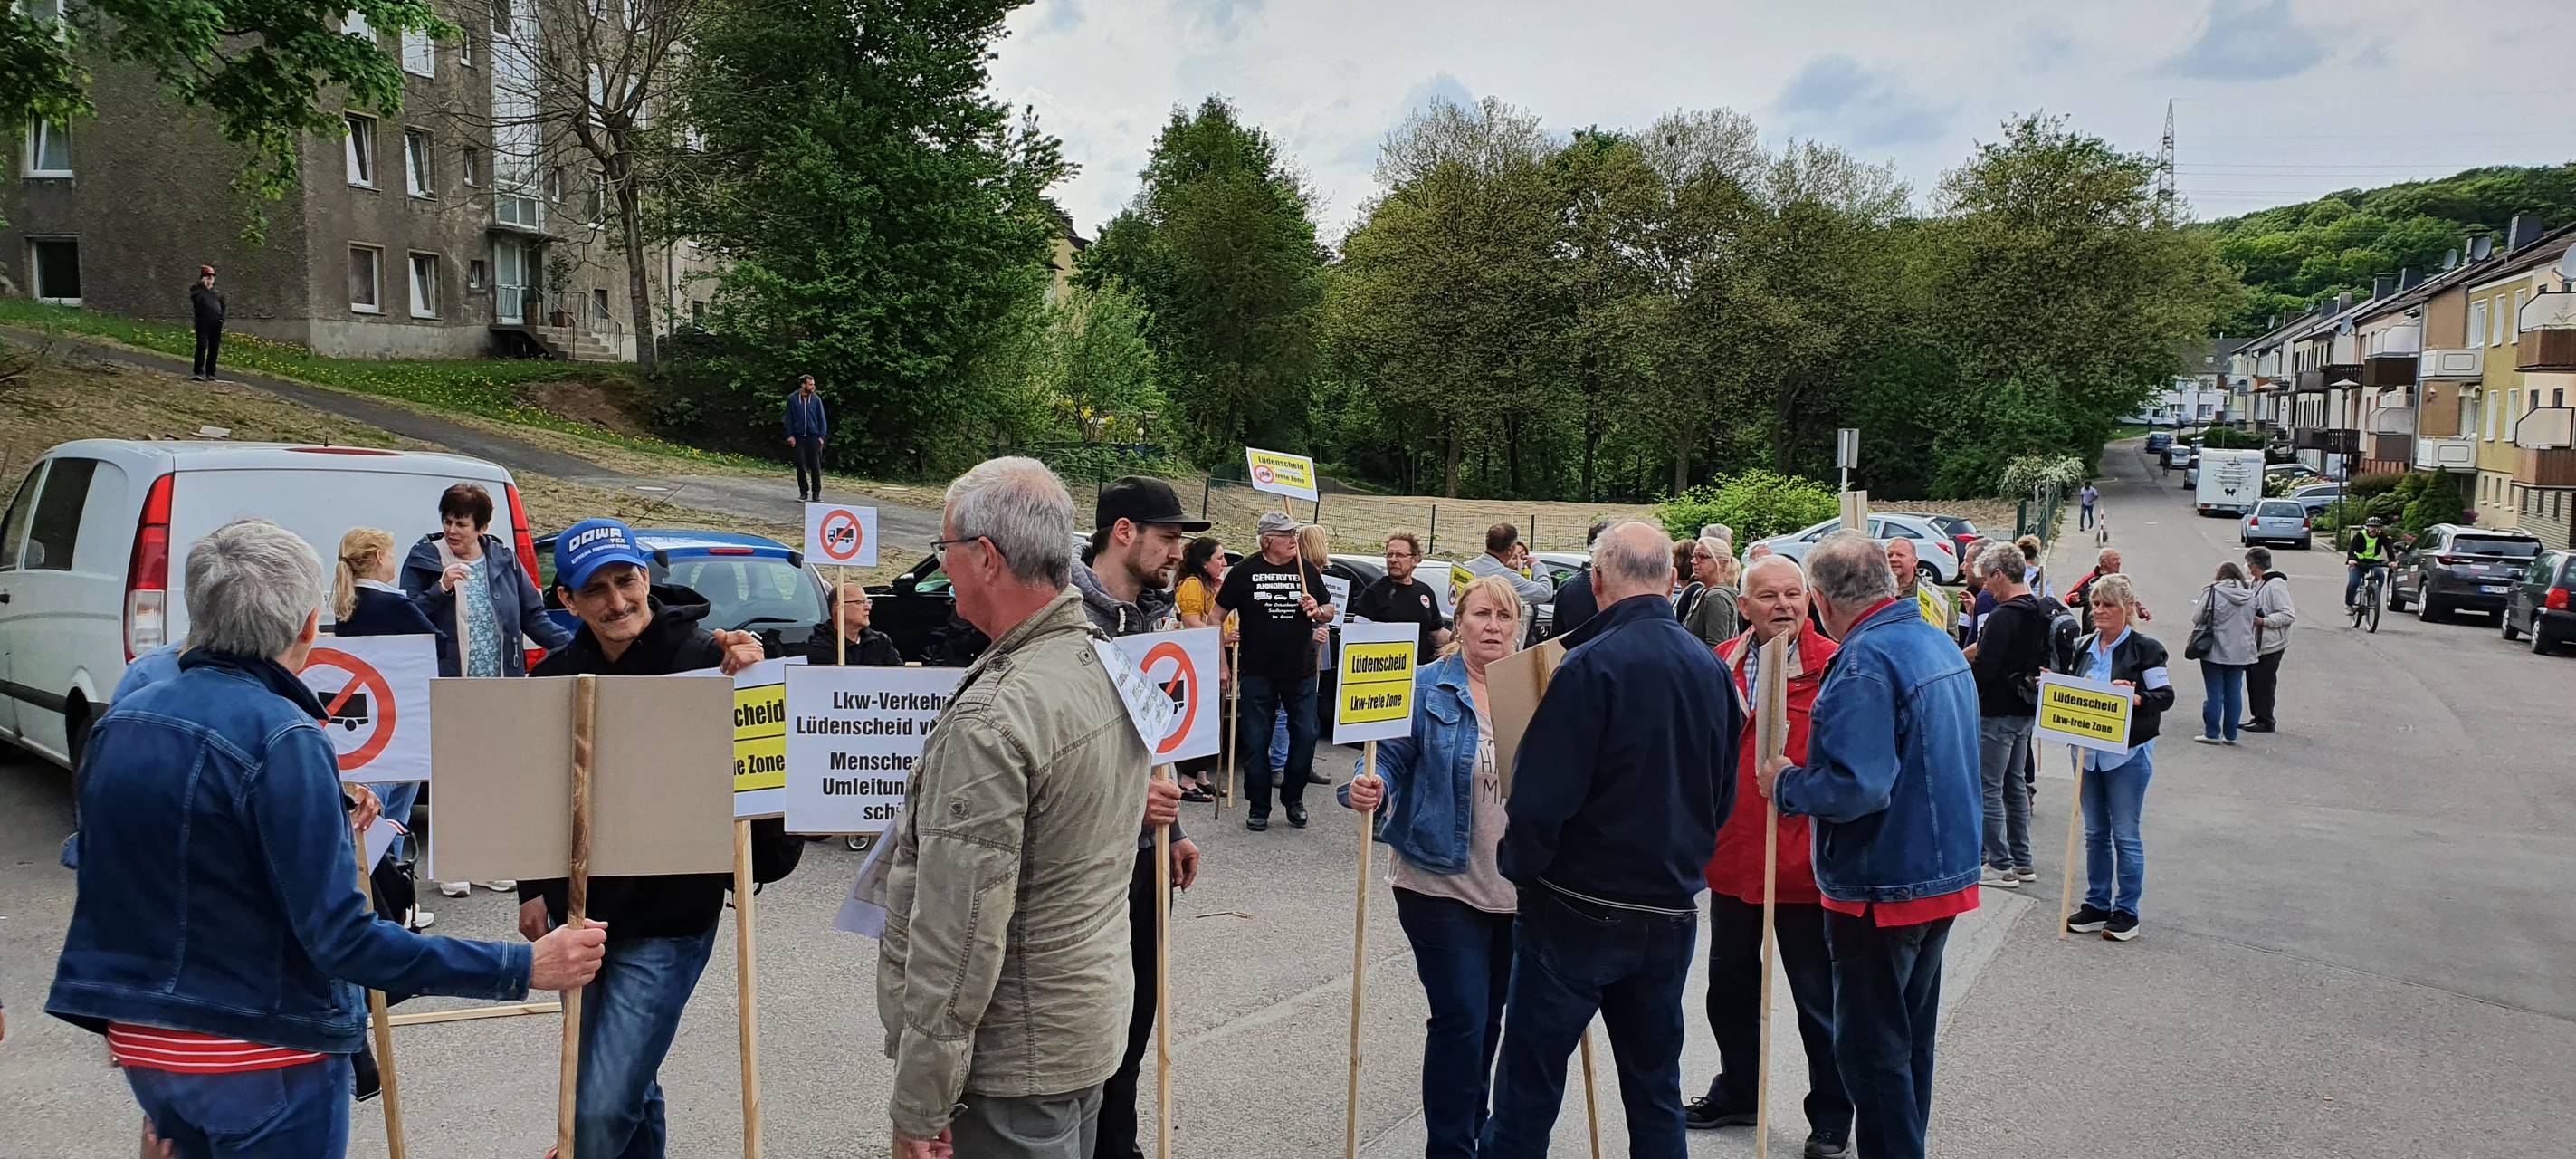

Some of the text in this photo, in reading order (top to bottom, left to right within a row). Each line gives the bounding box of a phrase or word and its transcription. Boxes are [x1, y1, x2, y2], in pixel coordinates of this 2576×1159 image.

[1258, 456, 1304, 470] Lüdenscheid
[1252, 573, 1302, 582] GENERVTE
[1351, 653, 1407, 674] Lüdenscheid
[1350, 693, 1402, 711] Lkw-freie Zone
[2053, 691, 2118, 713] Lüdenscheid
[797, 716, 913, 735] Lüdenscheid
[2052, 714, 2113, 733] Lkw-freie Zone
[748, 754, 785, 775] Zone
[830, 752, 919, 771] Mensche
[1480, 748, 1496, 774] H
[863, 802, 905, 820] sch
